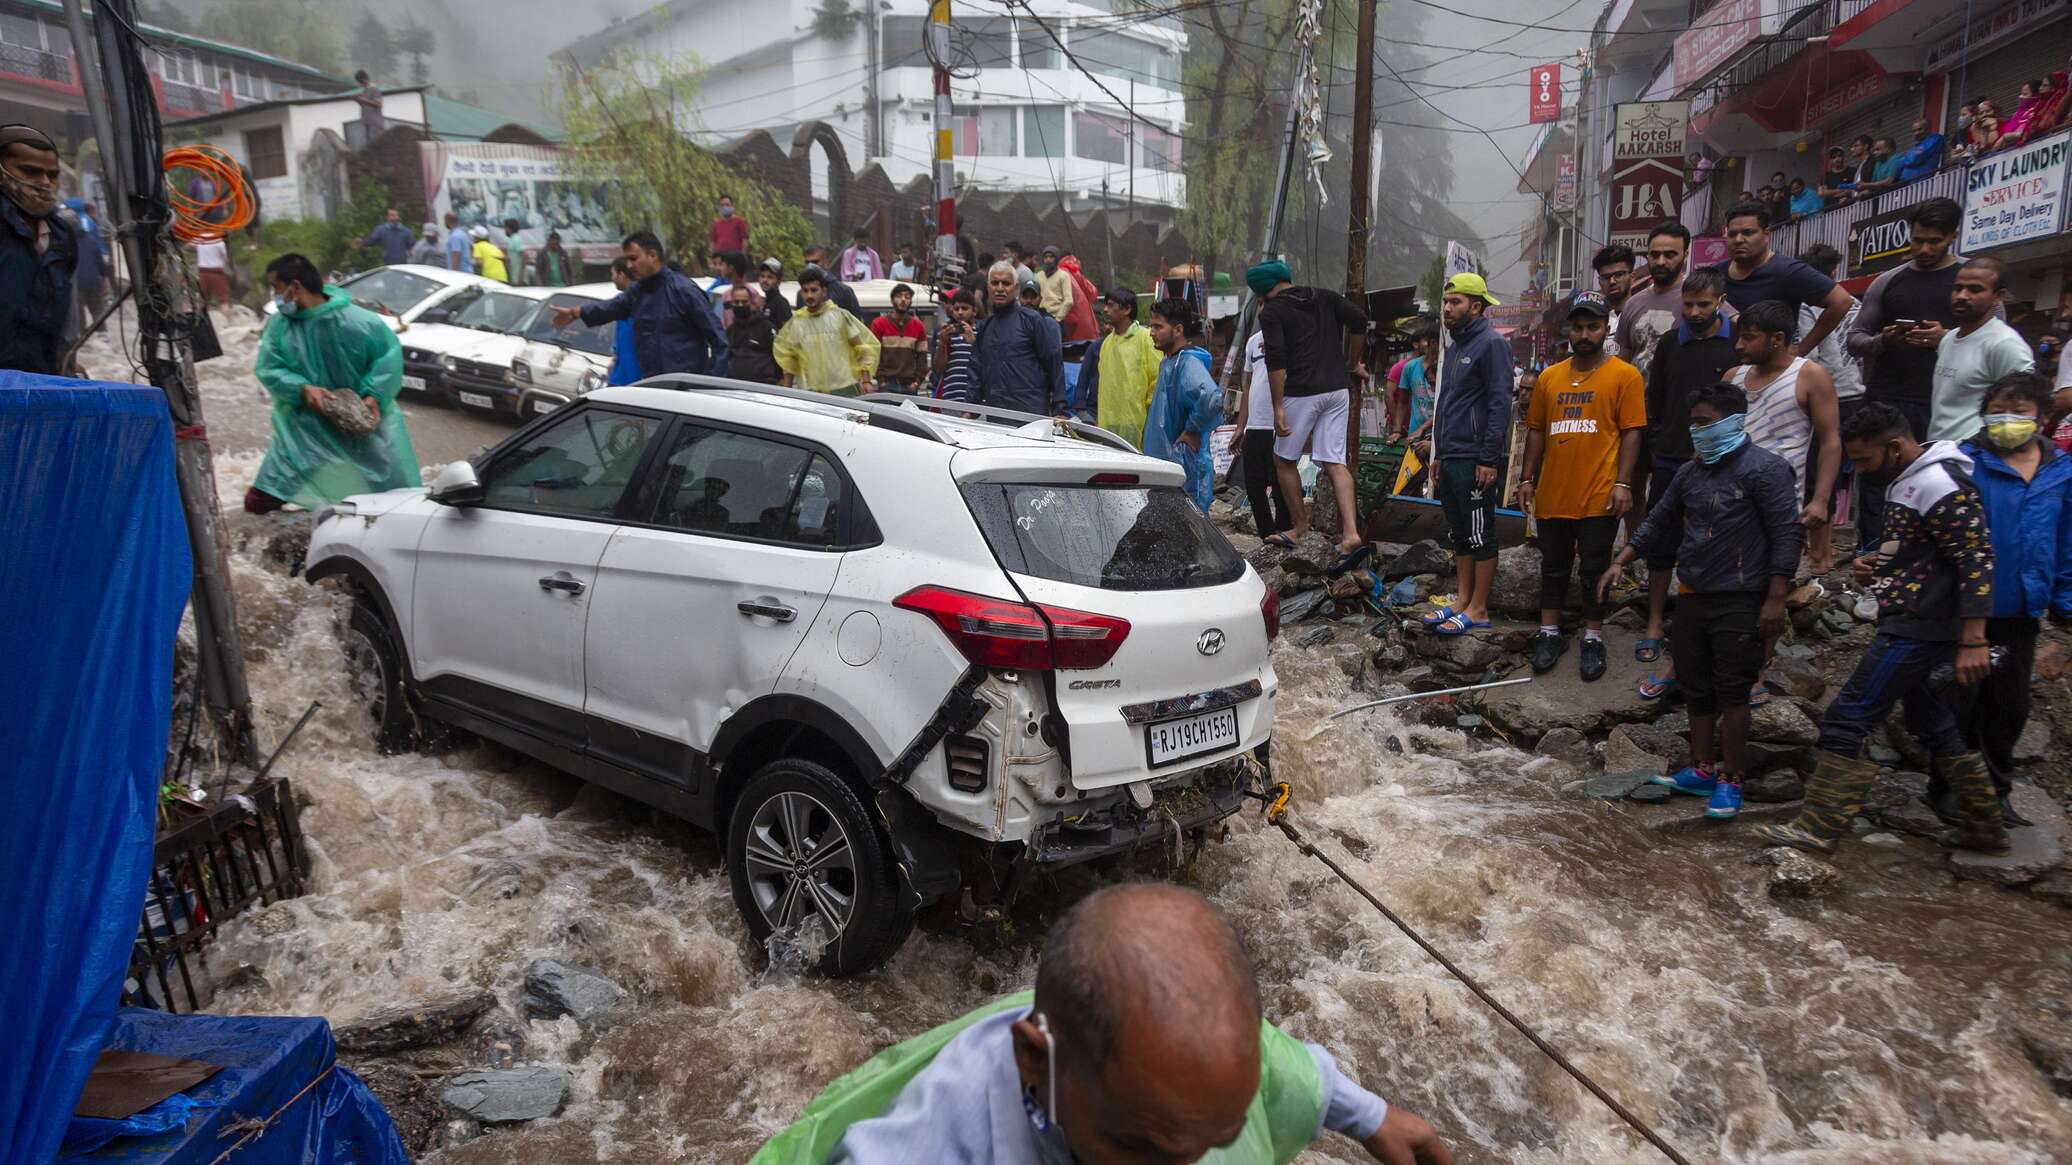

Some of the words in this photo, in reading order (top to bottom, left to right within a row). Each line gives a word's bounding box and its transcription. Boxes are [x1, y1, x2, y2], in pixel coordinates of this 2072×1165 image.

[1540, 72, 1551, 102] OYO
[1630, 127, 1672, 142] Hotel
[1617, 141, 1682, 156] AAKARSH
[1968, 163, 1998, 192] SKY
[2000, 141, 2070, 181] LAUNDRY
[1983, 177, 2044, 208] SERVICE
[1971, 215, 1997, 230] Same
[1999, 209, 2017, 226] Day
[2019, 202, 2055, 220] Delivery
[1573, 292, 1605, 306] VANS
[1557, 391, 1594, 405] STRIVE
[1563, 407, 1583, 419] FOR
[1068, 679, 1121, 690] CRETA
[1160, 714, 1233, 753] RJ19CH1550
